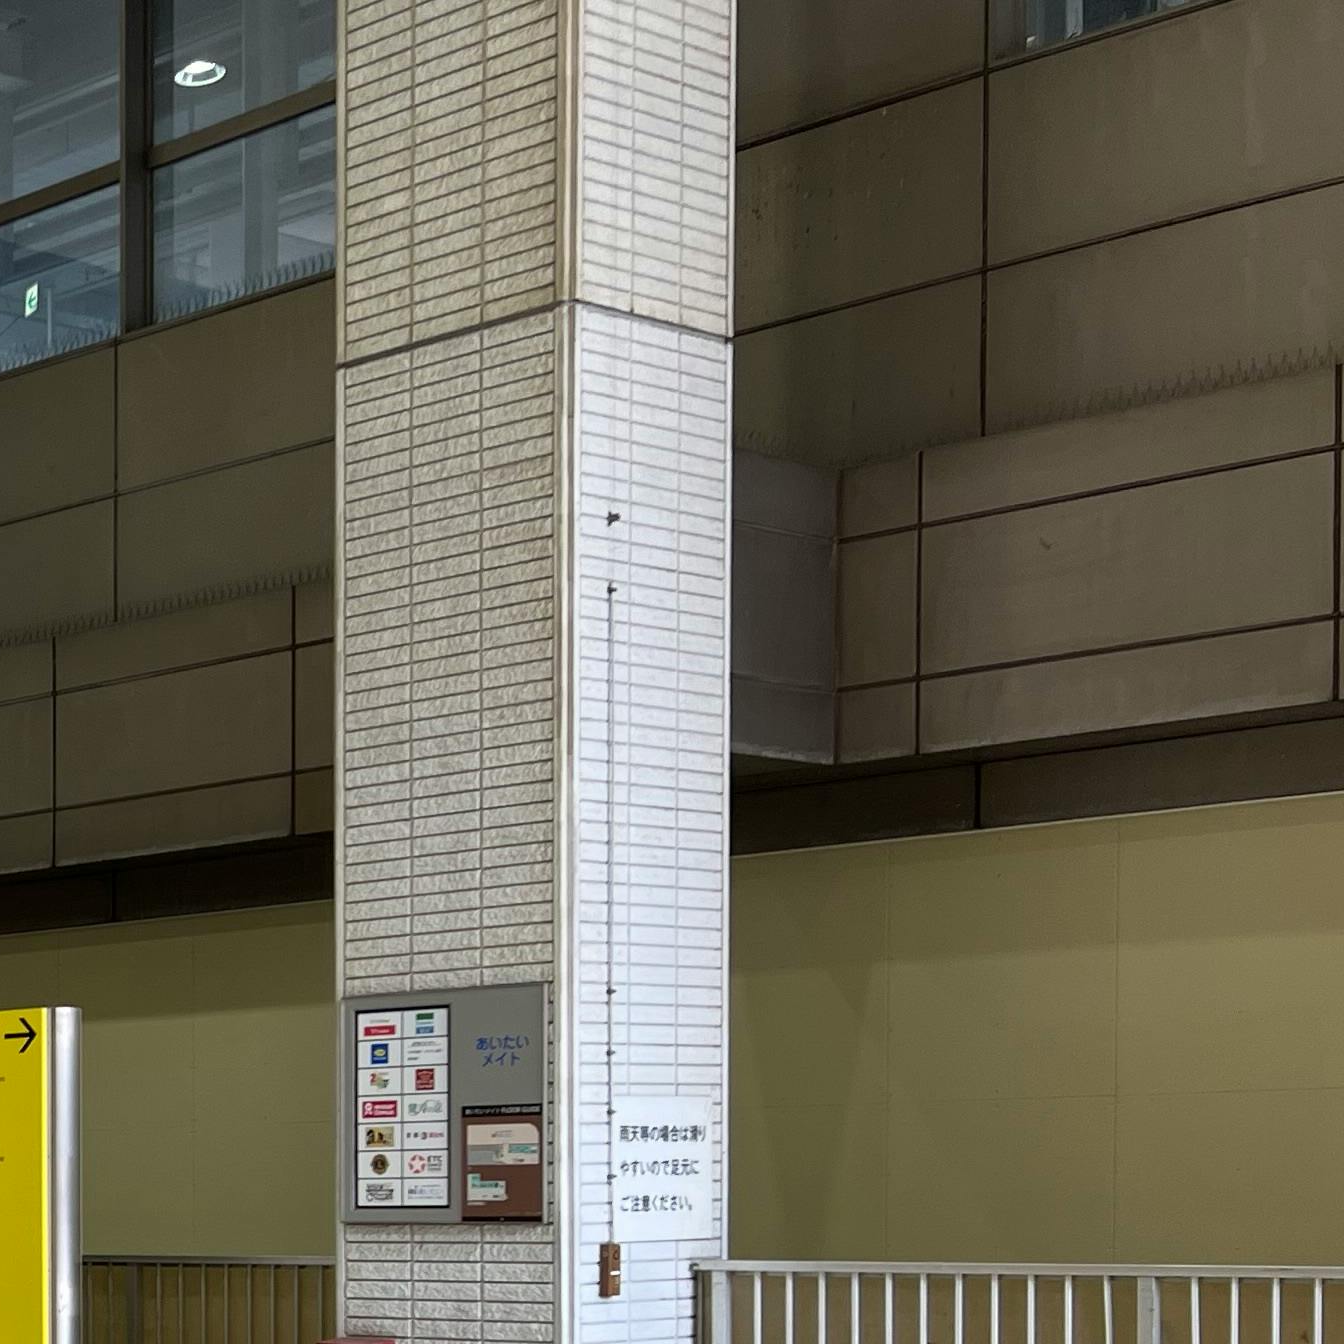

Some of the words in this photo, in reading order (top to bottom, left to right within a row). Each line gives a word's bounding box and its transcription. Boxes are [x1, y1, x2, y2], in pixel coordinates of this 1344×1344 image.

[476, 1035, 529, 1050] あいたい
[482, 1052, 521, 1067] メイト
[620, 1125, 706, 1142] 雨天等の場合は滑り
[620, 1159, 699, 1176] やすいので足元に
[620, 1195, 692, 1211] ご注意ください。
